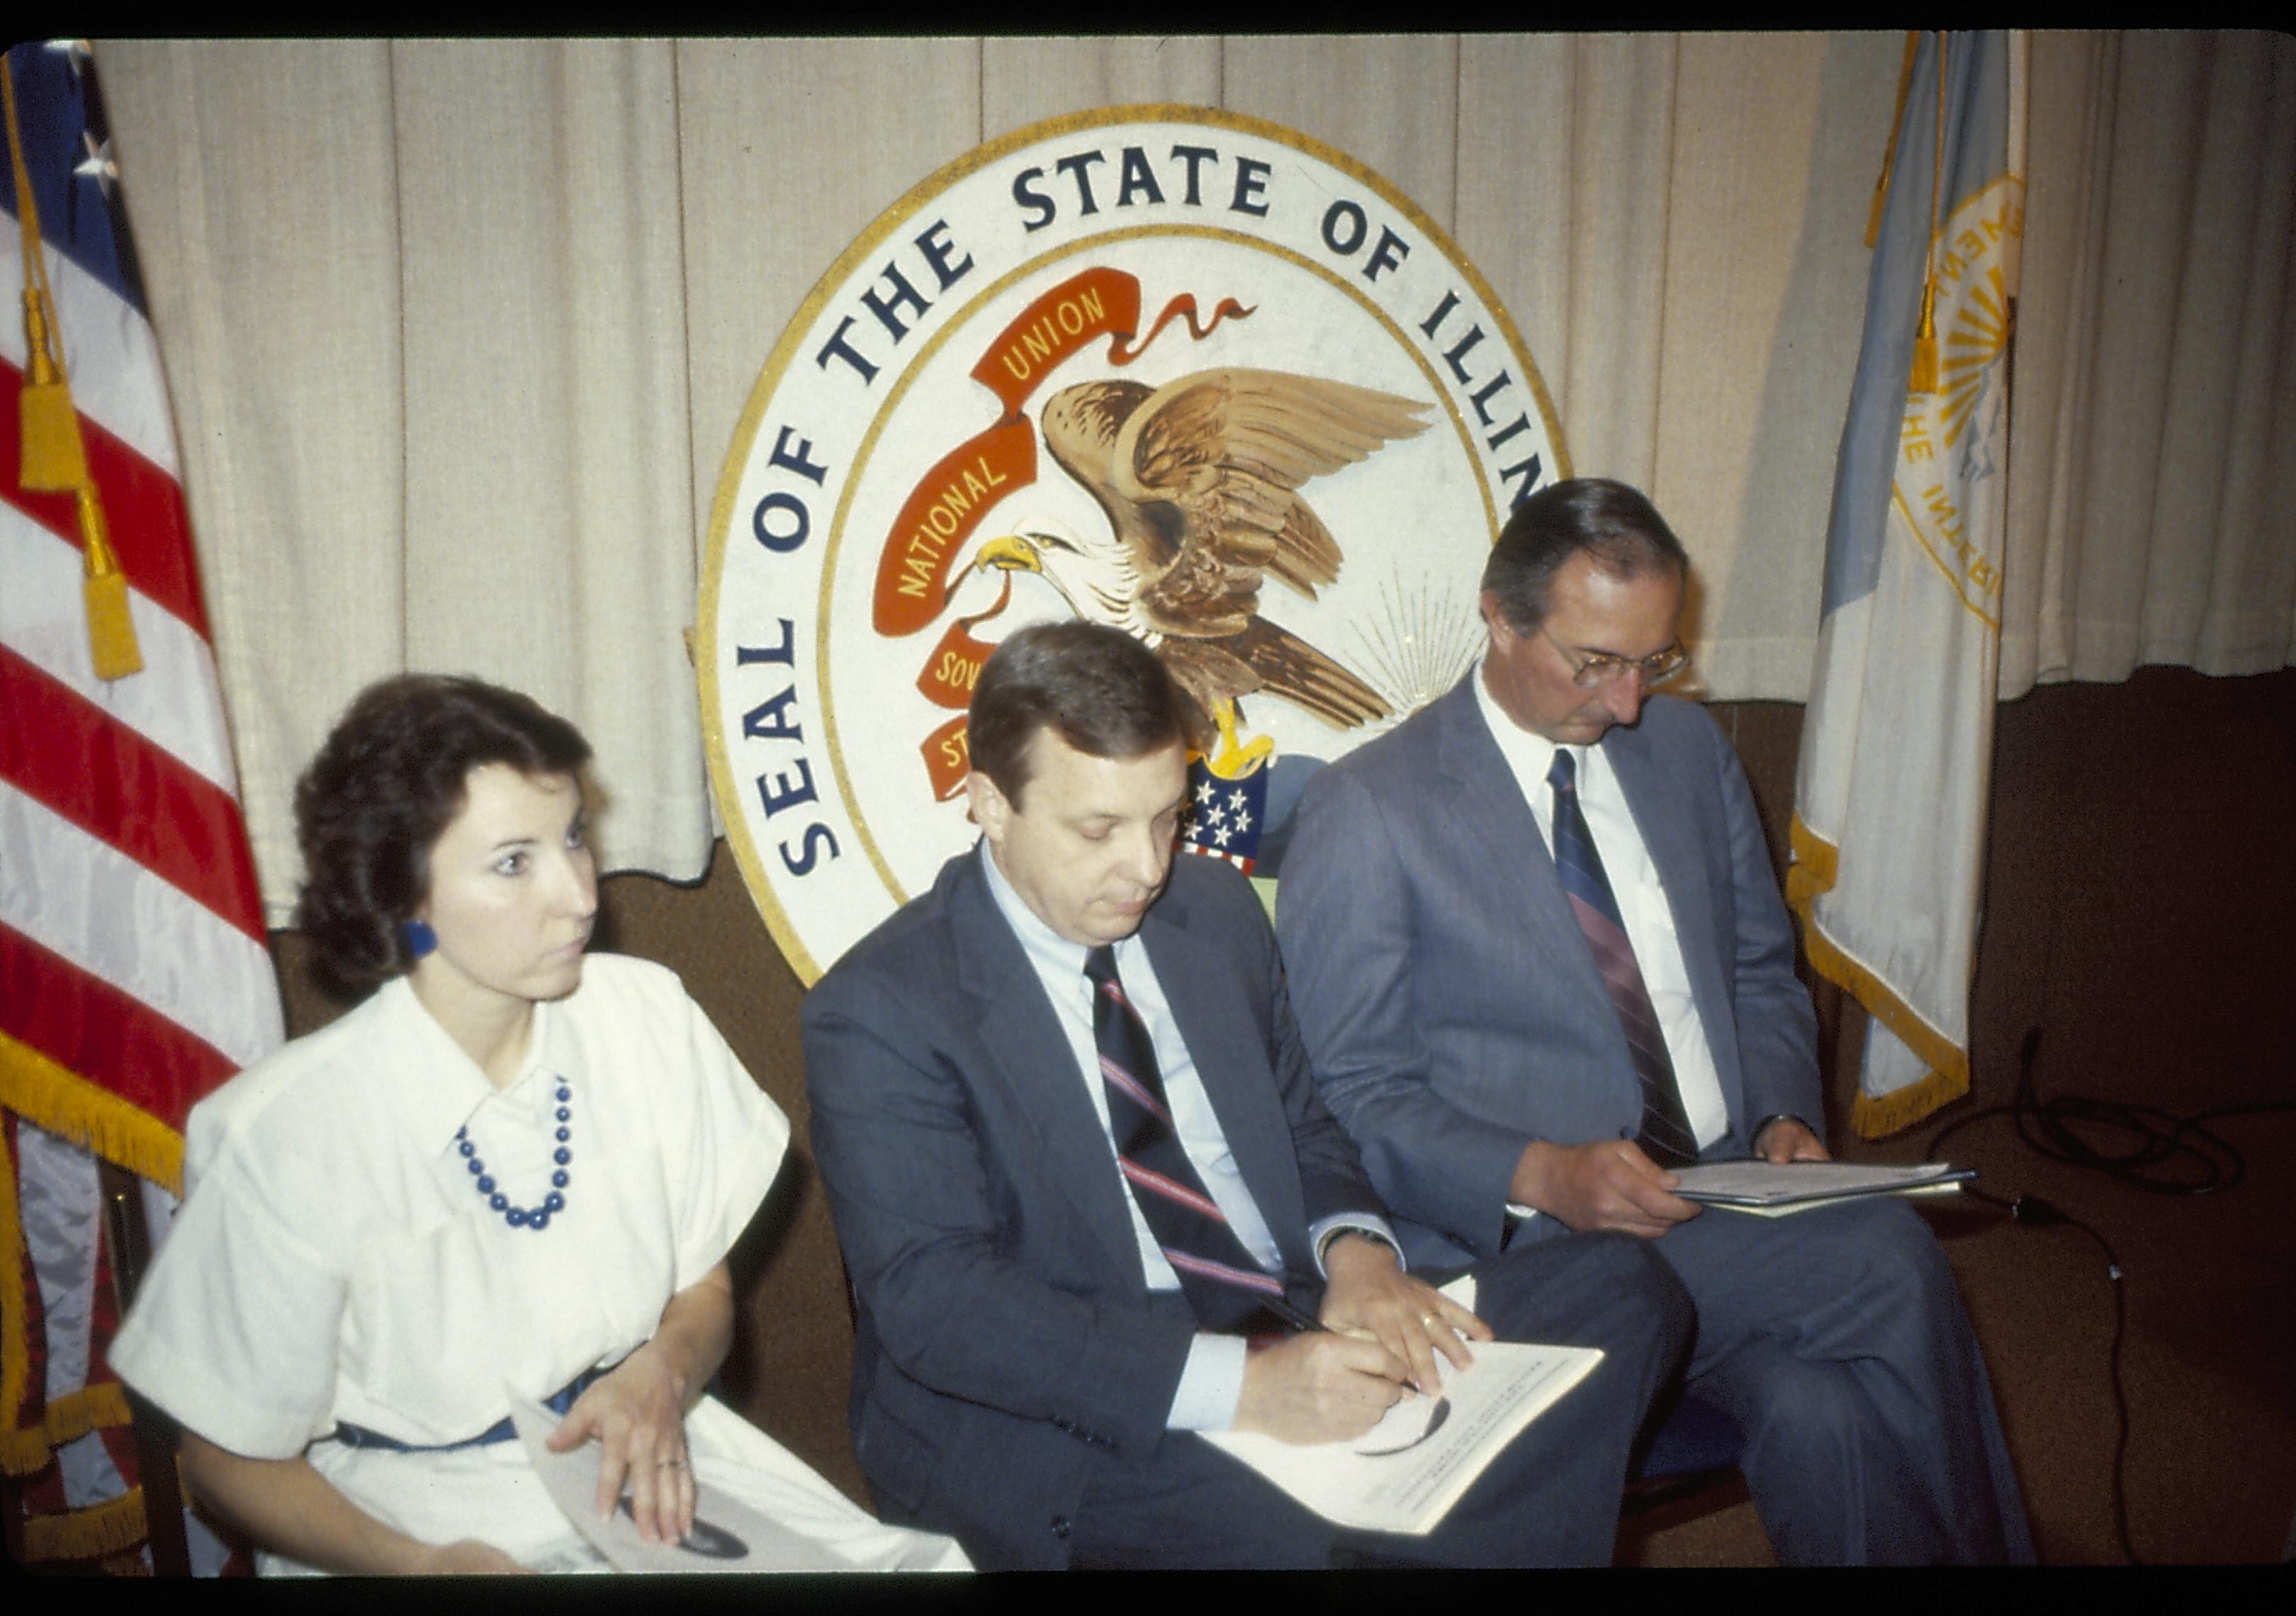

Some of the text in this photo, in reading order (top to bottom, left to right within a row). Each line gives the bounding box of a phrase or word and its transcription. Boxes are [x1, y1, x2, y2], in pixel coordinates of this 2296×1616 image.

[1012, 145, 1272, 232] STATE
[1322, 199, 1410, 282] OF
[816, 219, 974, 387] THE
[752, 425, 829, 554] OF
[897, 288, 1104, 597] NATIONAL UNION
[736, 618, 840, 877] SEAL
